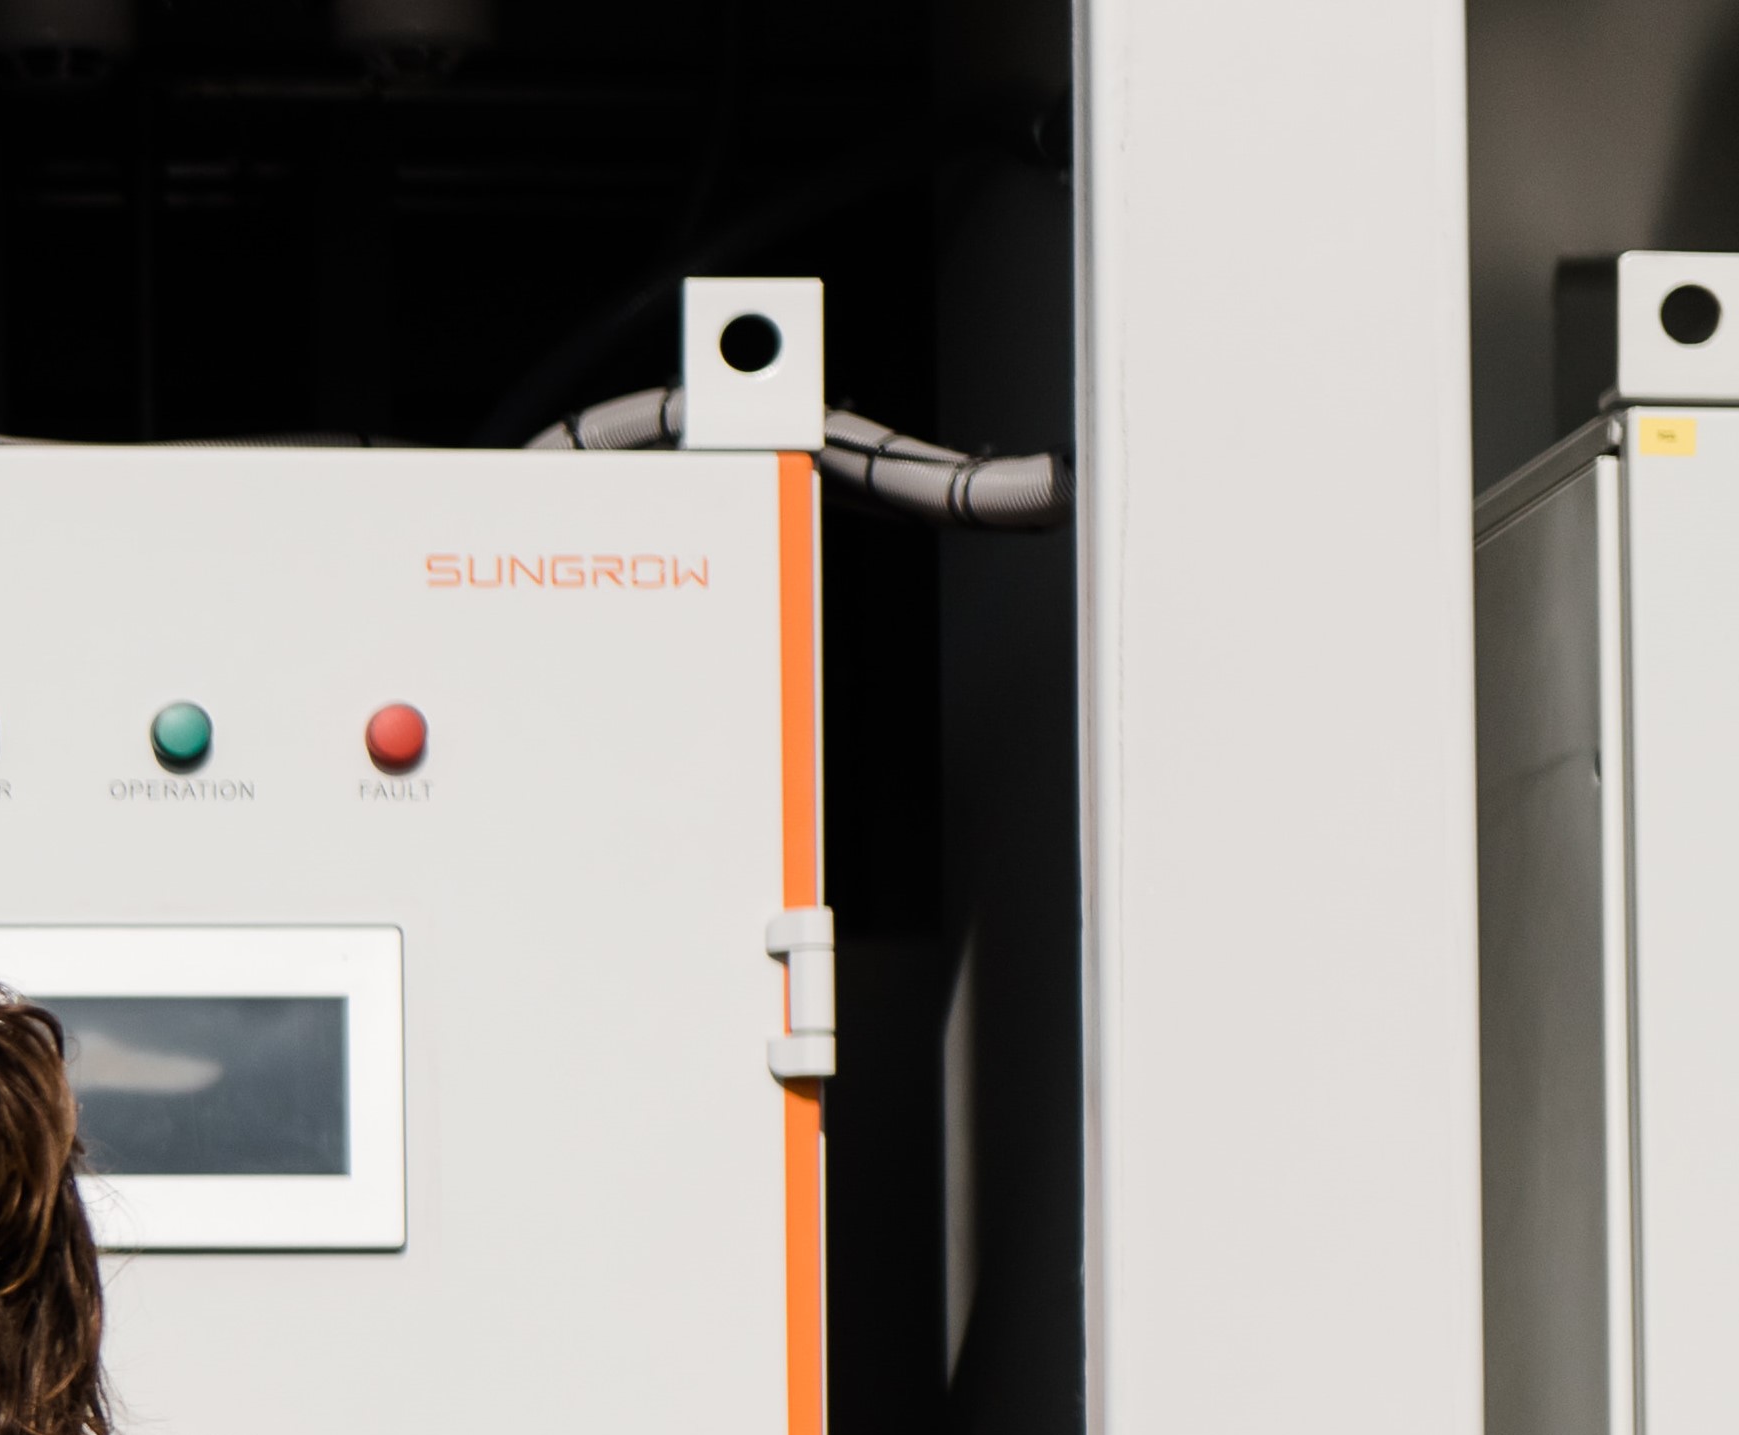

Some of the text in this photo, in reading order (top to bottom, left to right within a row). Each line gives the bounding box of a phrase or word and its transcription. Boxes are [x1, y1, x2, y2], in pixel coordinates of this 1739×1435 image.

[425, 553, 710, 588] SUNGROW
[109, 778, 255, 801] OPERATION
[359, 778, 433, 801] FAULT
